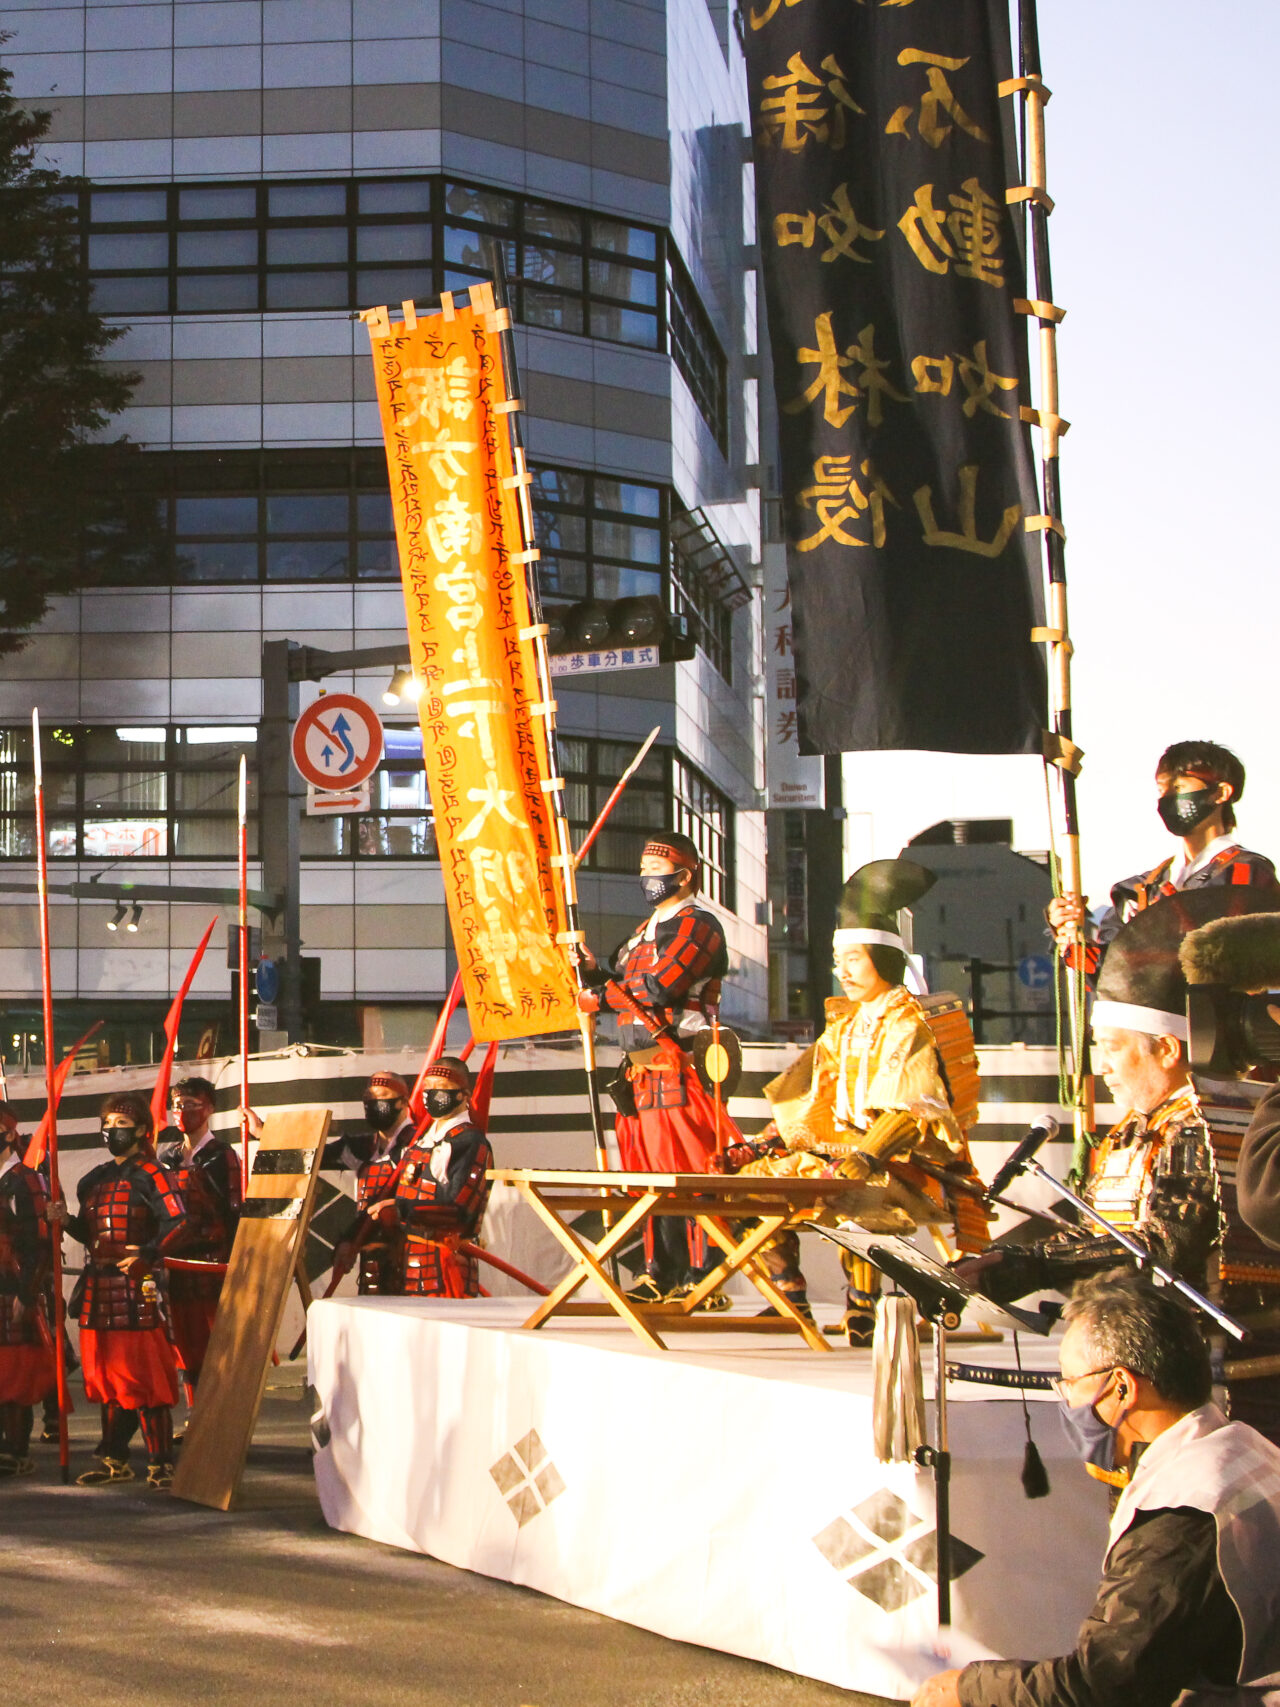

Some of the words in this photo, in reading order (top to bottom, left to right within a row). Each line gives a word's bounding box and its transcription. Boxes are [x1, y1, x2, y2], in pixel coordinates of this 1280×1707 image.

[571, 648, 652, 669] 歩車分離式
